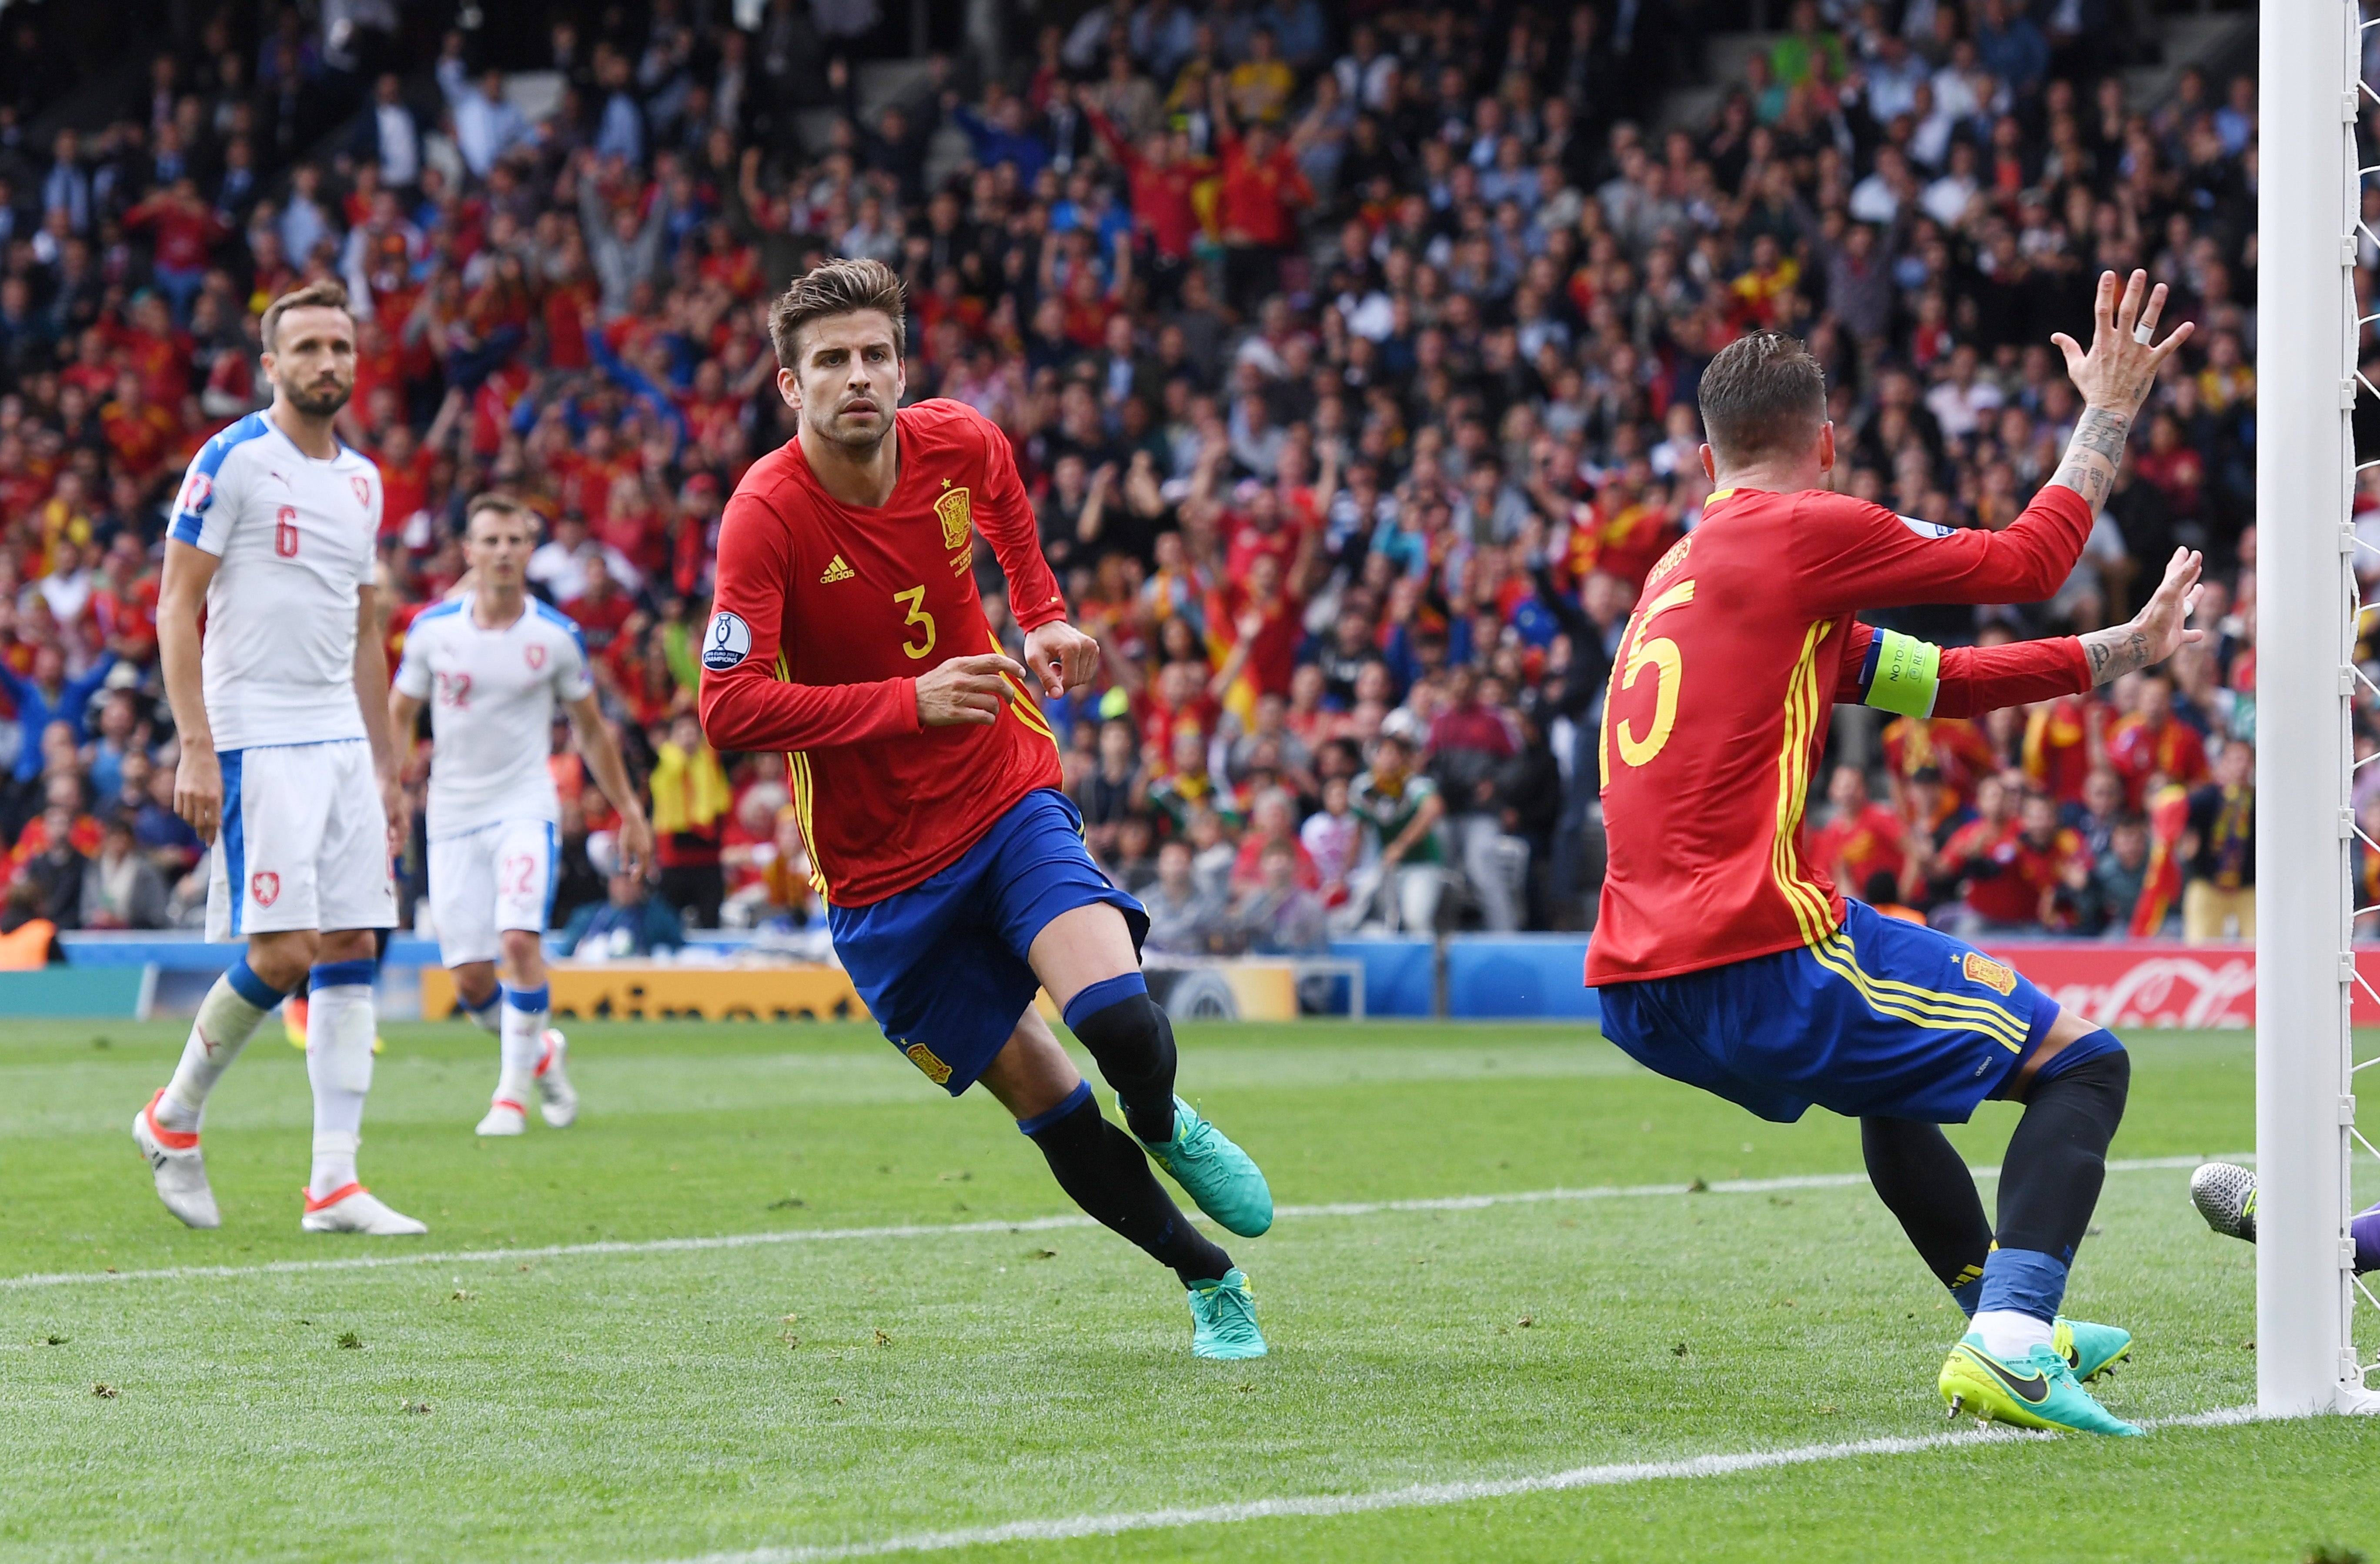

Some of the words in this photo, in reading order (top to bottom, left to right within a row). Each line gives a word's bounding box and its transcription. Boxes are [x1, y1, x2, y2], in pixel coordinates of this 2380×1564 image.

[275, 506, 298, 558] 6
[820, 569, 855, 584] adidas
[893, 584, 936, 660] 3
[1894, 650, 1904, 662] TO
[1889, 664, 1901, 682] NO
[499, 854, 535, 894] 22
